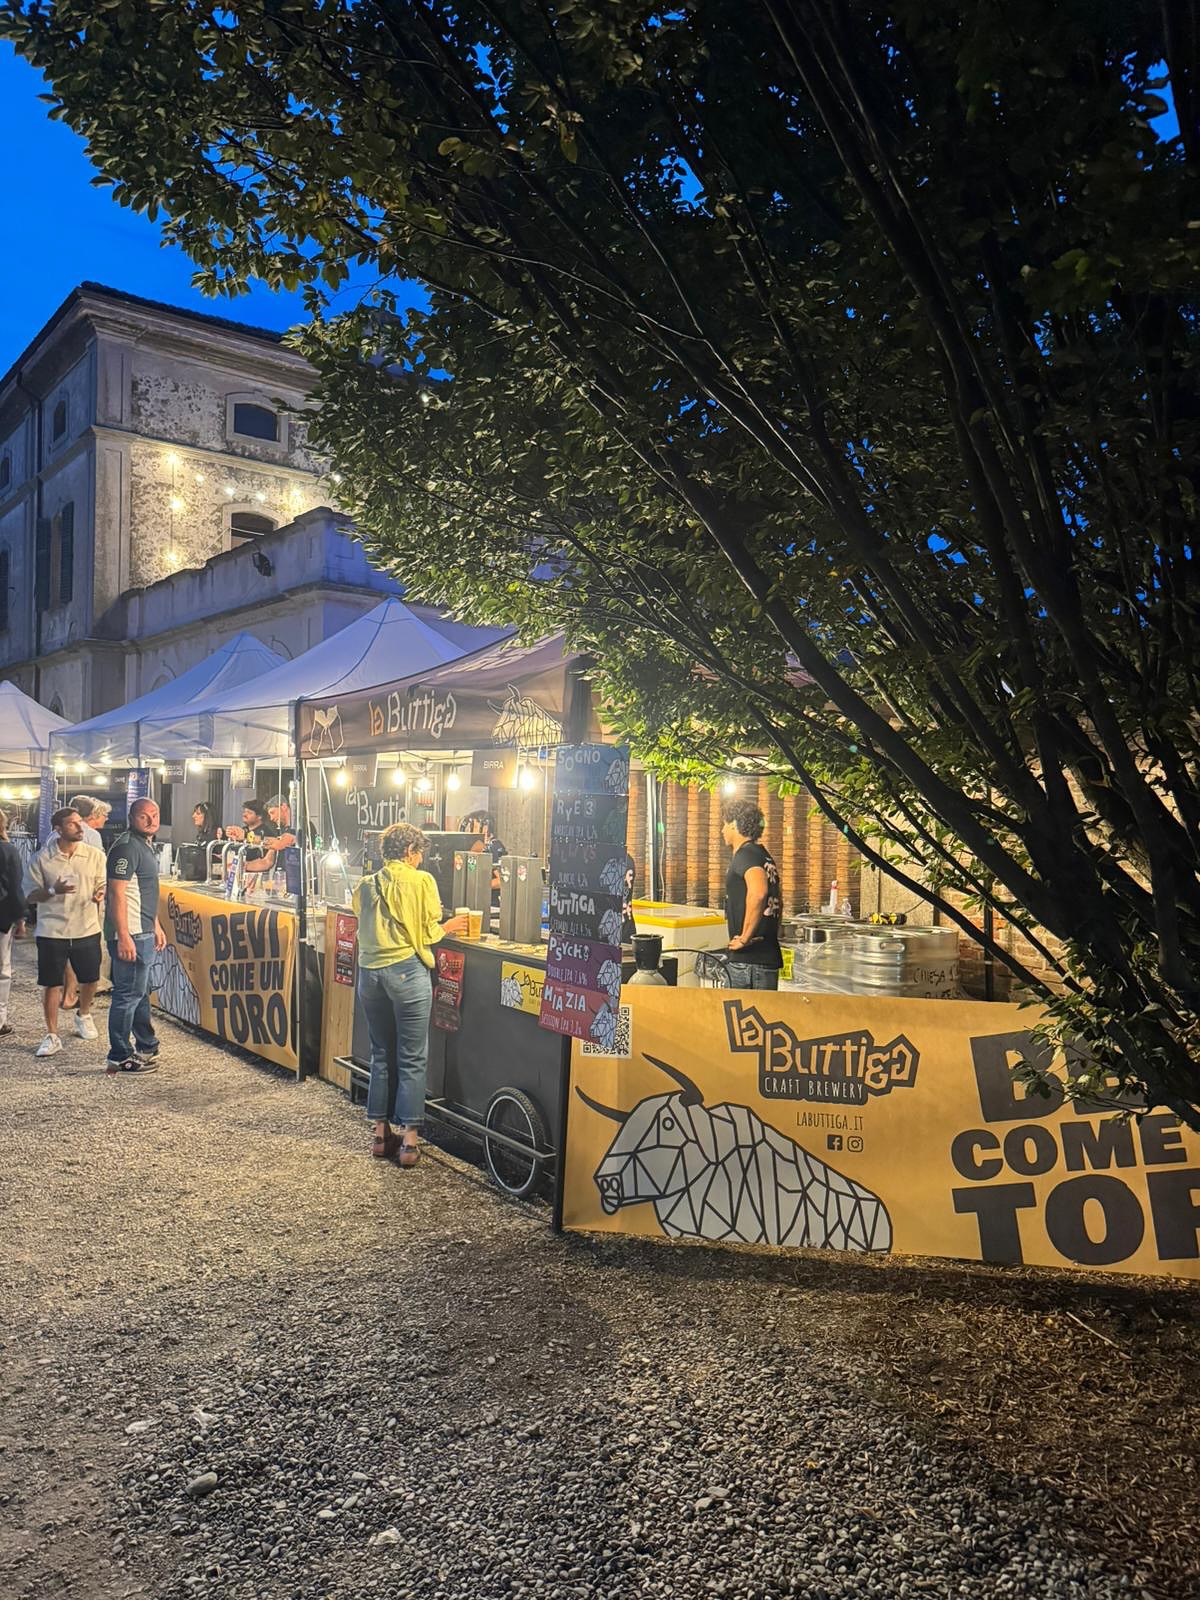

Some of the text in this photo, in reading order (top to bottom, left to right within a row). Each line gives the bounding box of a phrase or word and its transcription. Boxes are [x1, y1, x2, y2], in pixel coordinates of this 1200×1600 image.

[558, 750, 600, 772] SOGNO
[557, 799, 581, 822] RYE
[115, 858, 129, 875] 2
[551, 888, 595, 916] BUTTIGA
[211, 908, 281, 961] BEVI
[210, 960, 285, 992] COME UN
[565, 991, 586, 1012] ZIA
[212, 992, 288, 1047] TORO
[764, 1077, 864, 1099] CRAFT BREWERY
[797, 1111, 864, 1131] LABUTTIGA.IT
[951, 1113, 1188, 1181] COME
